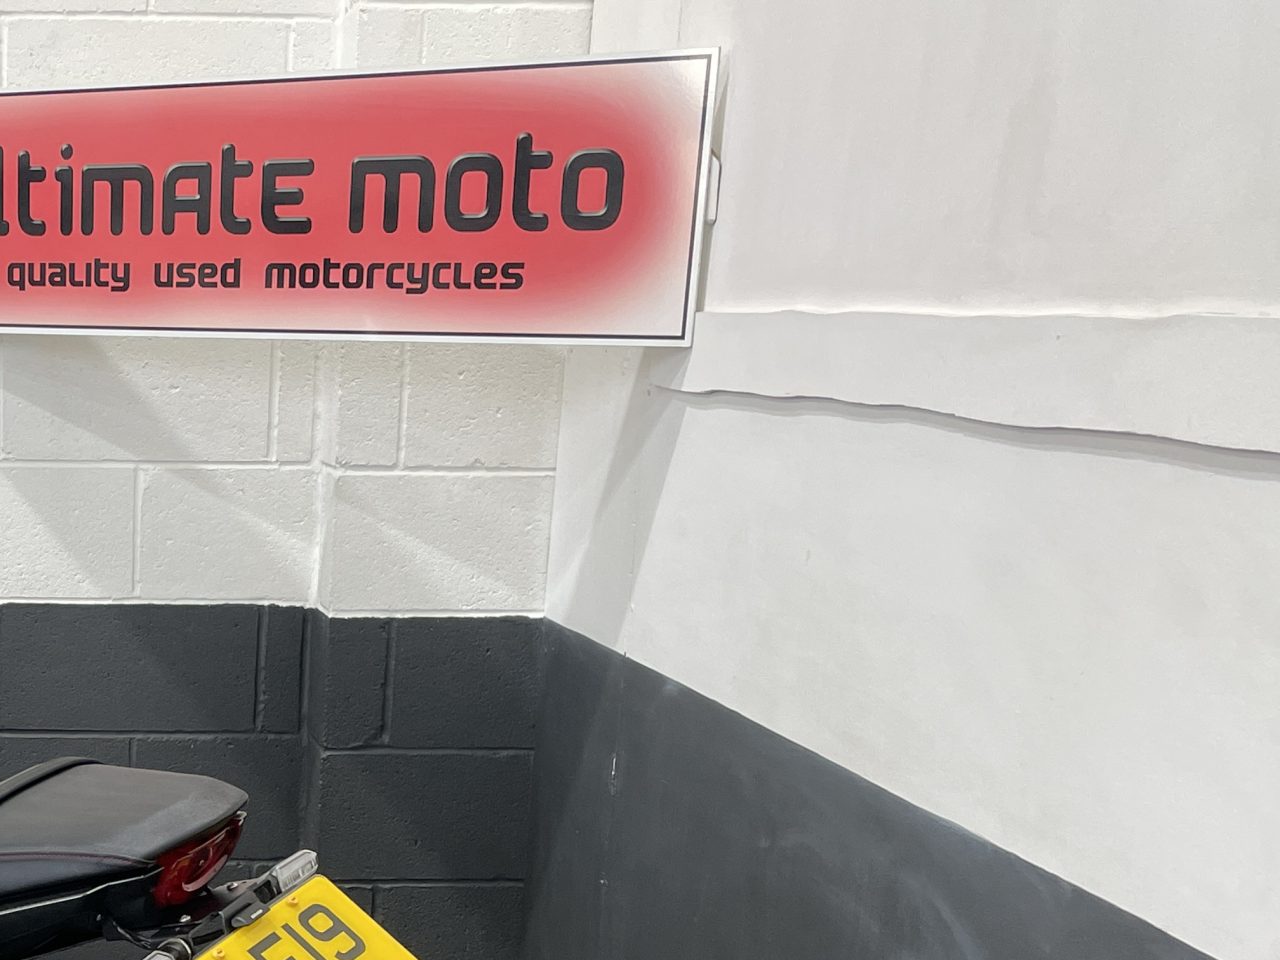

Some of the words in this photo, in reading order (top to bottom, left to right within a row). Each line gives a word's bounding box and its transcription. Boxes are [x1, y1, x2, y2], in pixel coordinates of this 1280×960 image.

[8, 258, 130, 292] quality
[154, 258, 241, 288] used
[265, 258, 525, 295] motorcycles
